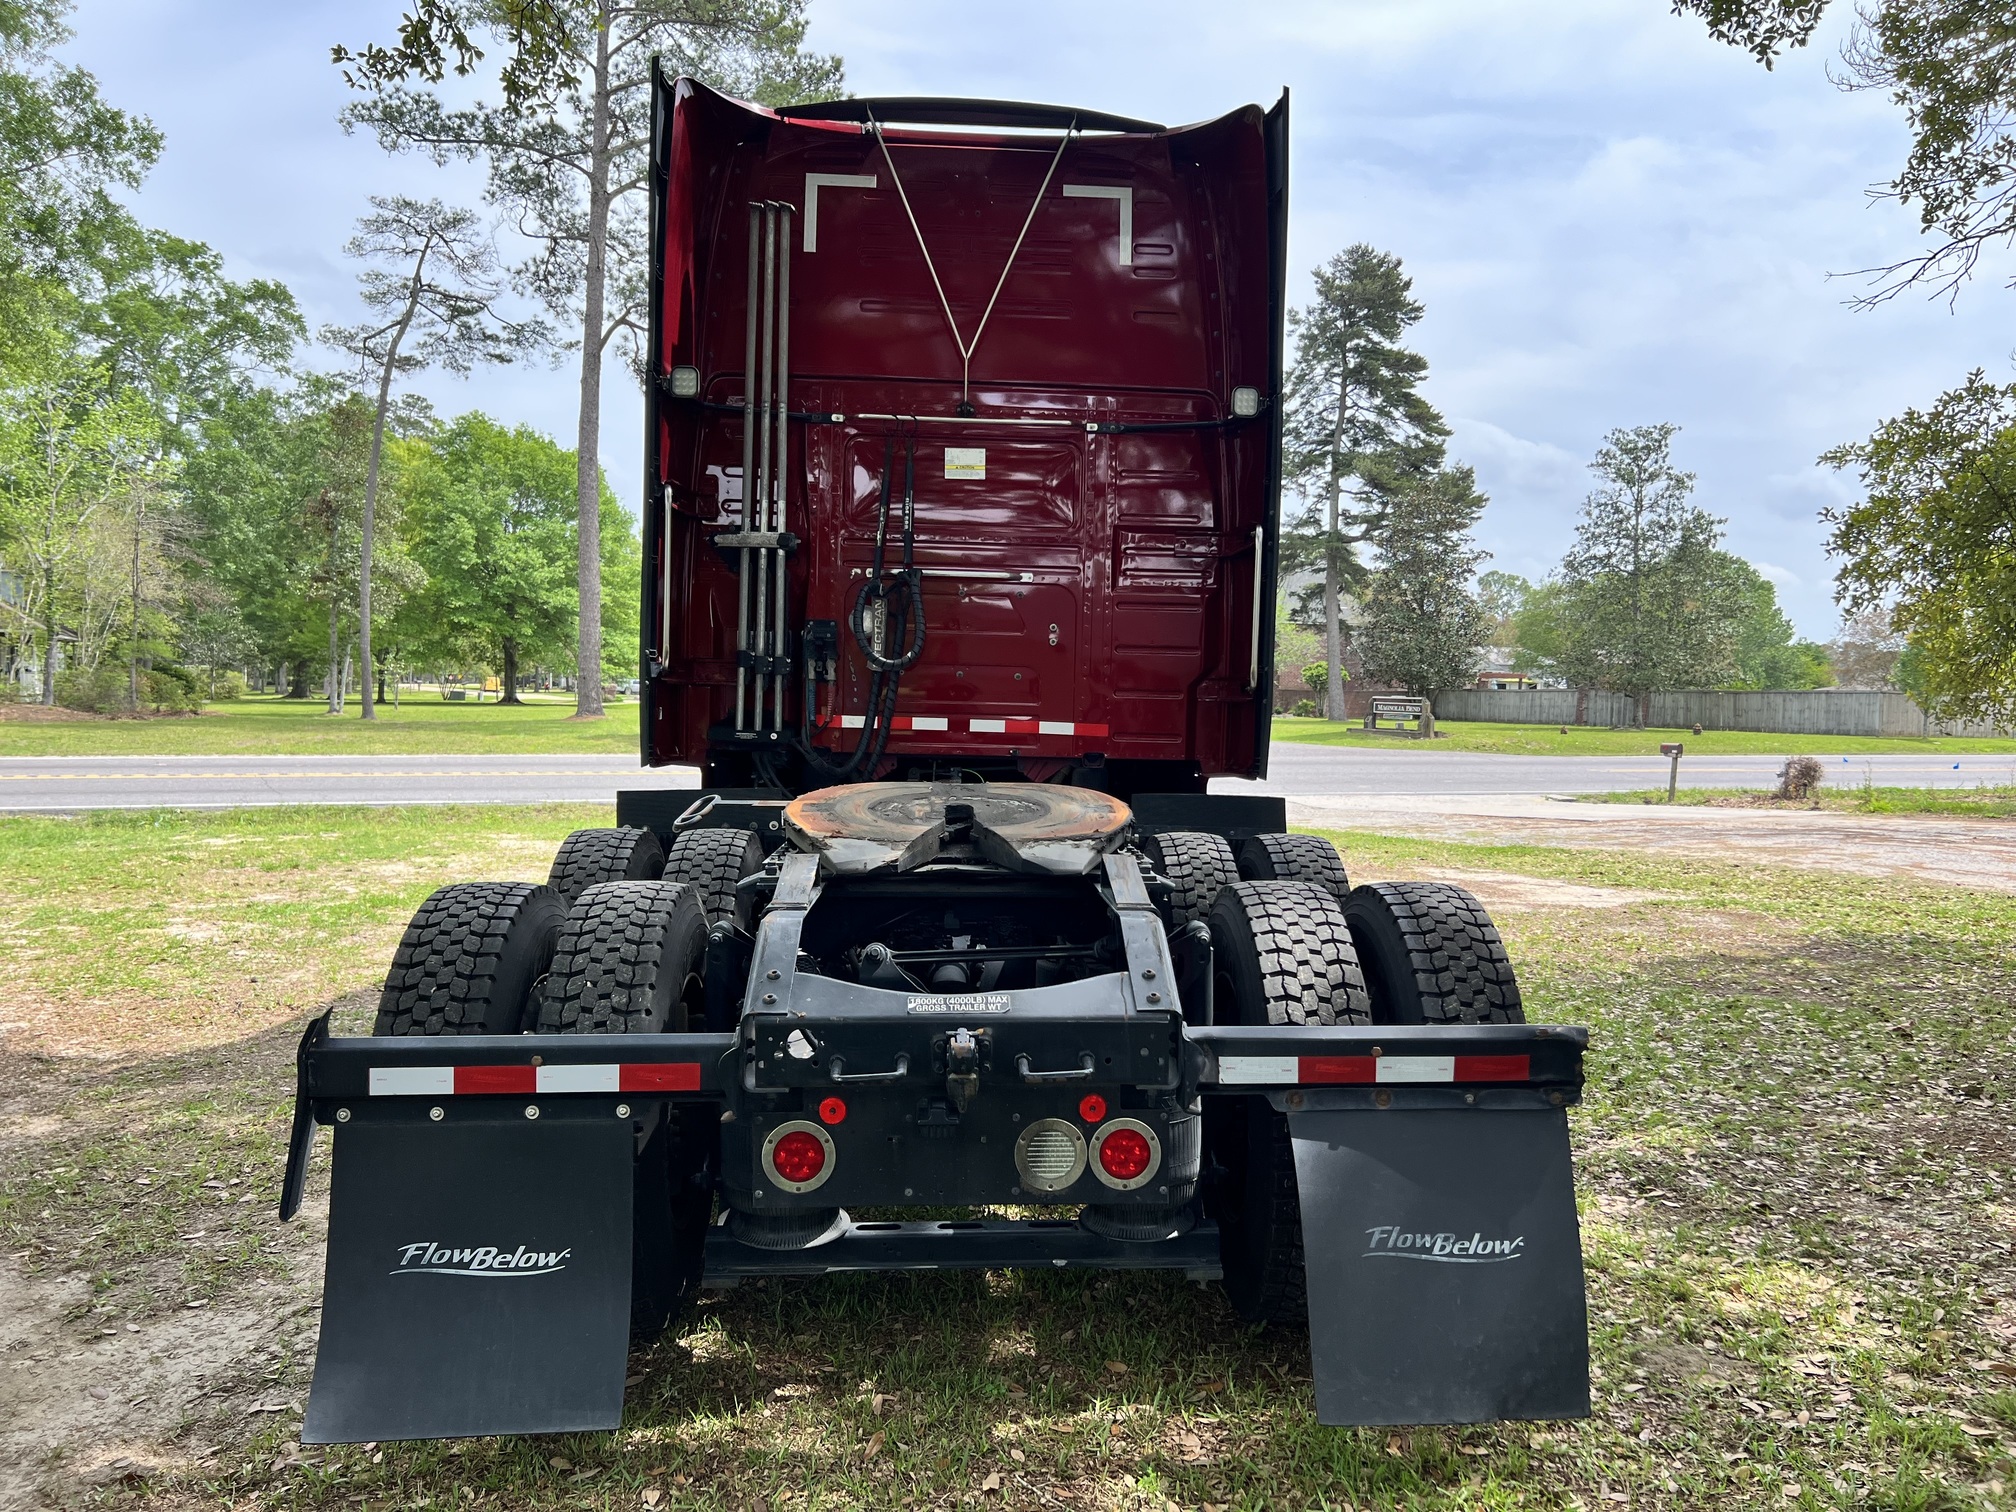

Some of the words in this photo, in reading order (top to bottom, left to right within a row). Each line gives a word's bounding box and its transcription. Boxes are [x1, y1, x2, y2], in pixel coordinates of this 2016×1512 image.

[946, 997, 985, 1005] (4000LB)
[949, 1003, 986, 1011] TRAILER
[1365, 1225, 1524, 1255] FlowBelow
[397, 1242, 571, 1270] FlowBelow
